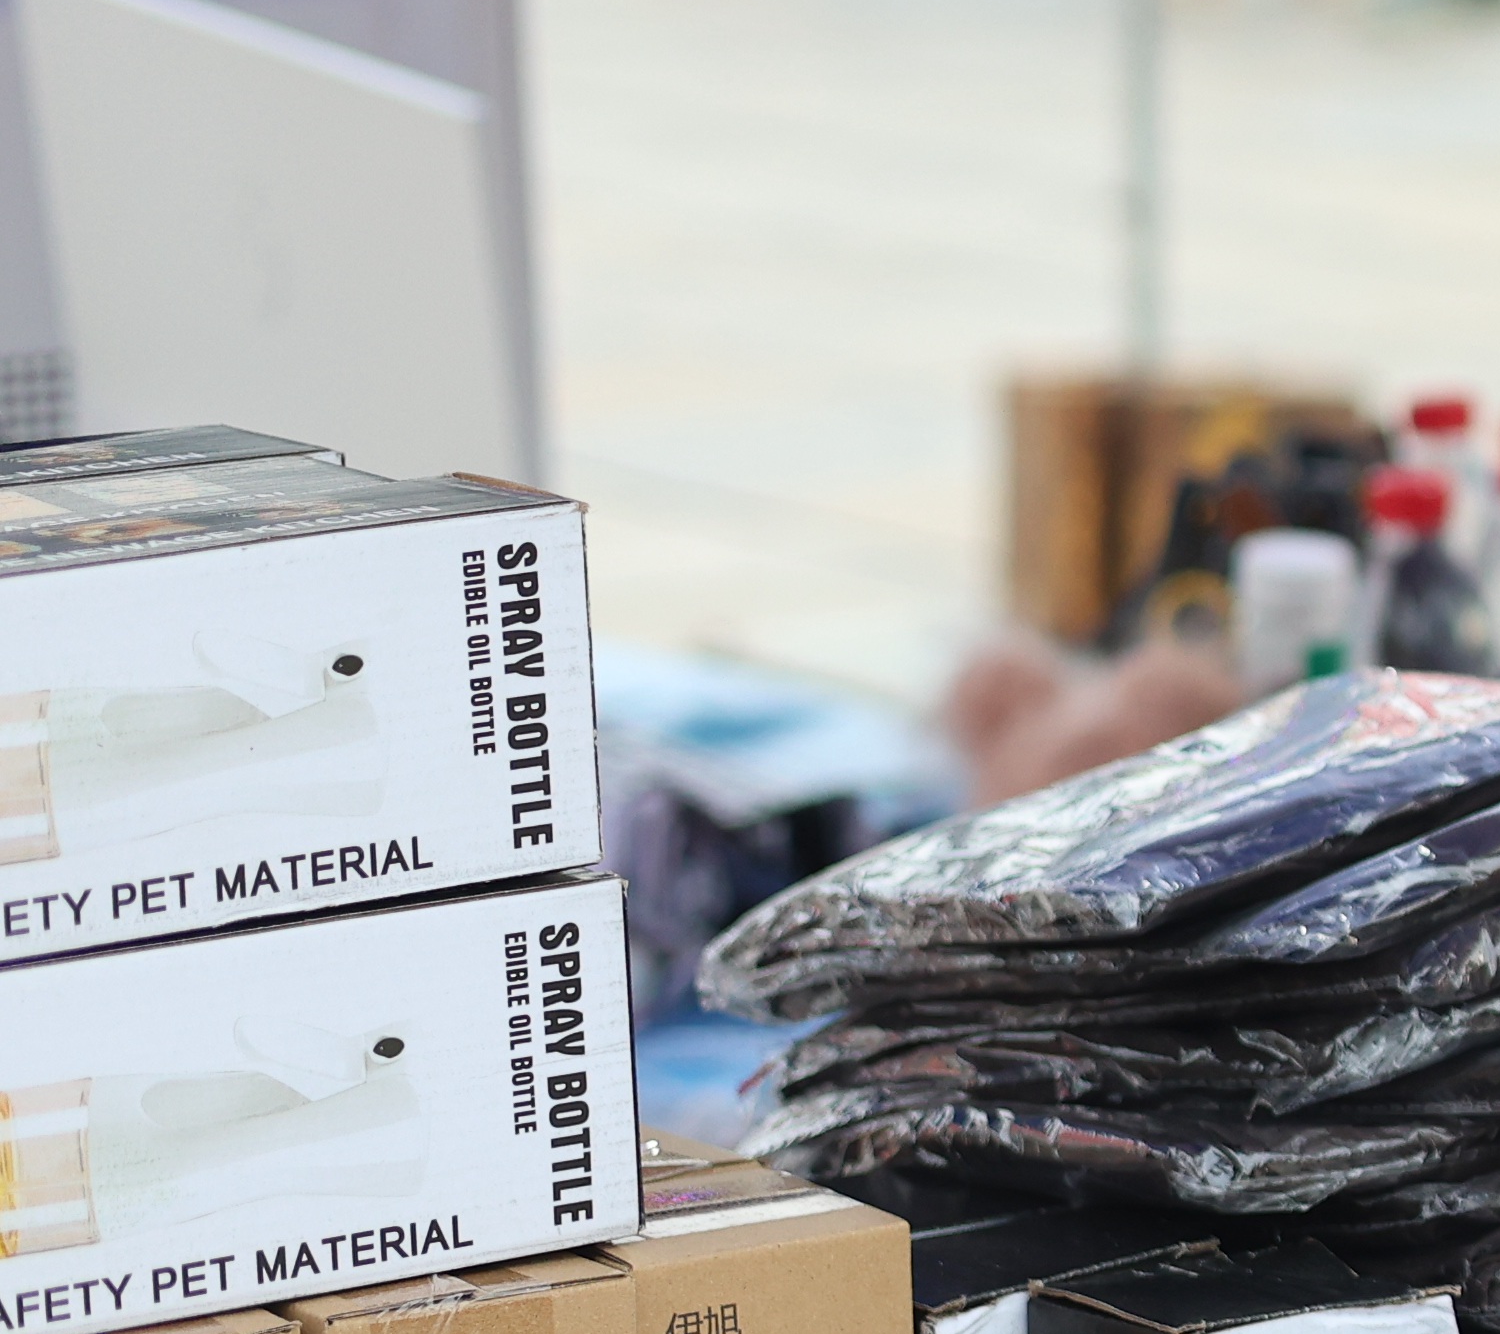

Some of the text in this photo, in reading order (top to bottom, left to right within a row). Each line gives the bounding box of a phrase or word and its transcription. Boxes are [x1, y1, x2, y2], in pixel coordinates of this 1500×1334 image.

[462, 550, 496, 756] EDIBLE OIL BOTTLE
[497, 542, 553, 849] SPRAY BOTTLE
[111, 873, 195, 918] PET
[216, 836, 433, 901] MATERIAL
[504, 931, 538, 1135] EDIBLE OIL BOTTLE
[539, 922, 594, 1226] SPRAY BOTTLE
[152, 1255, 235, 1303] PET
[256, 1214, 474, 1284] MATERIAL
